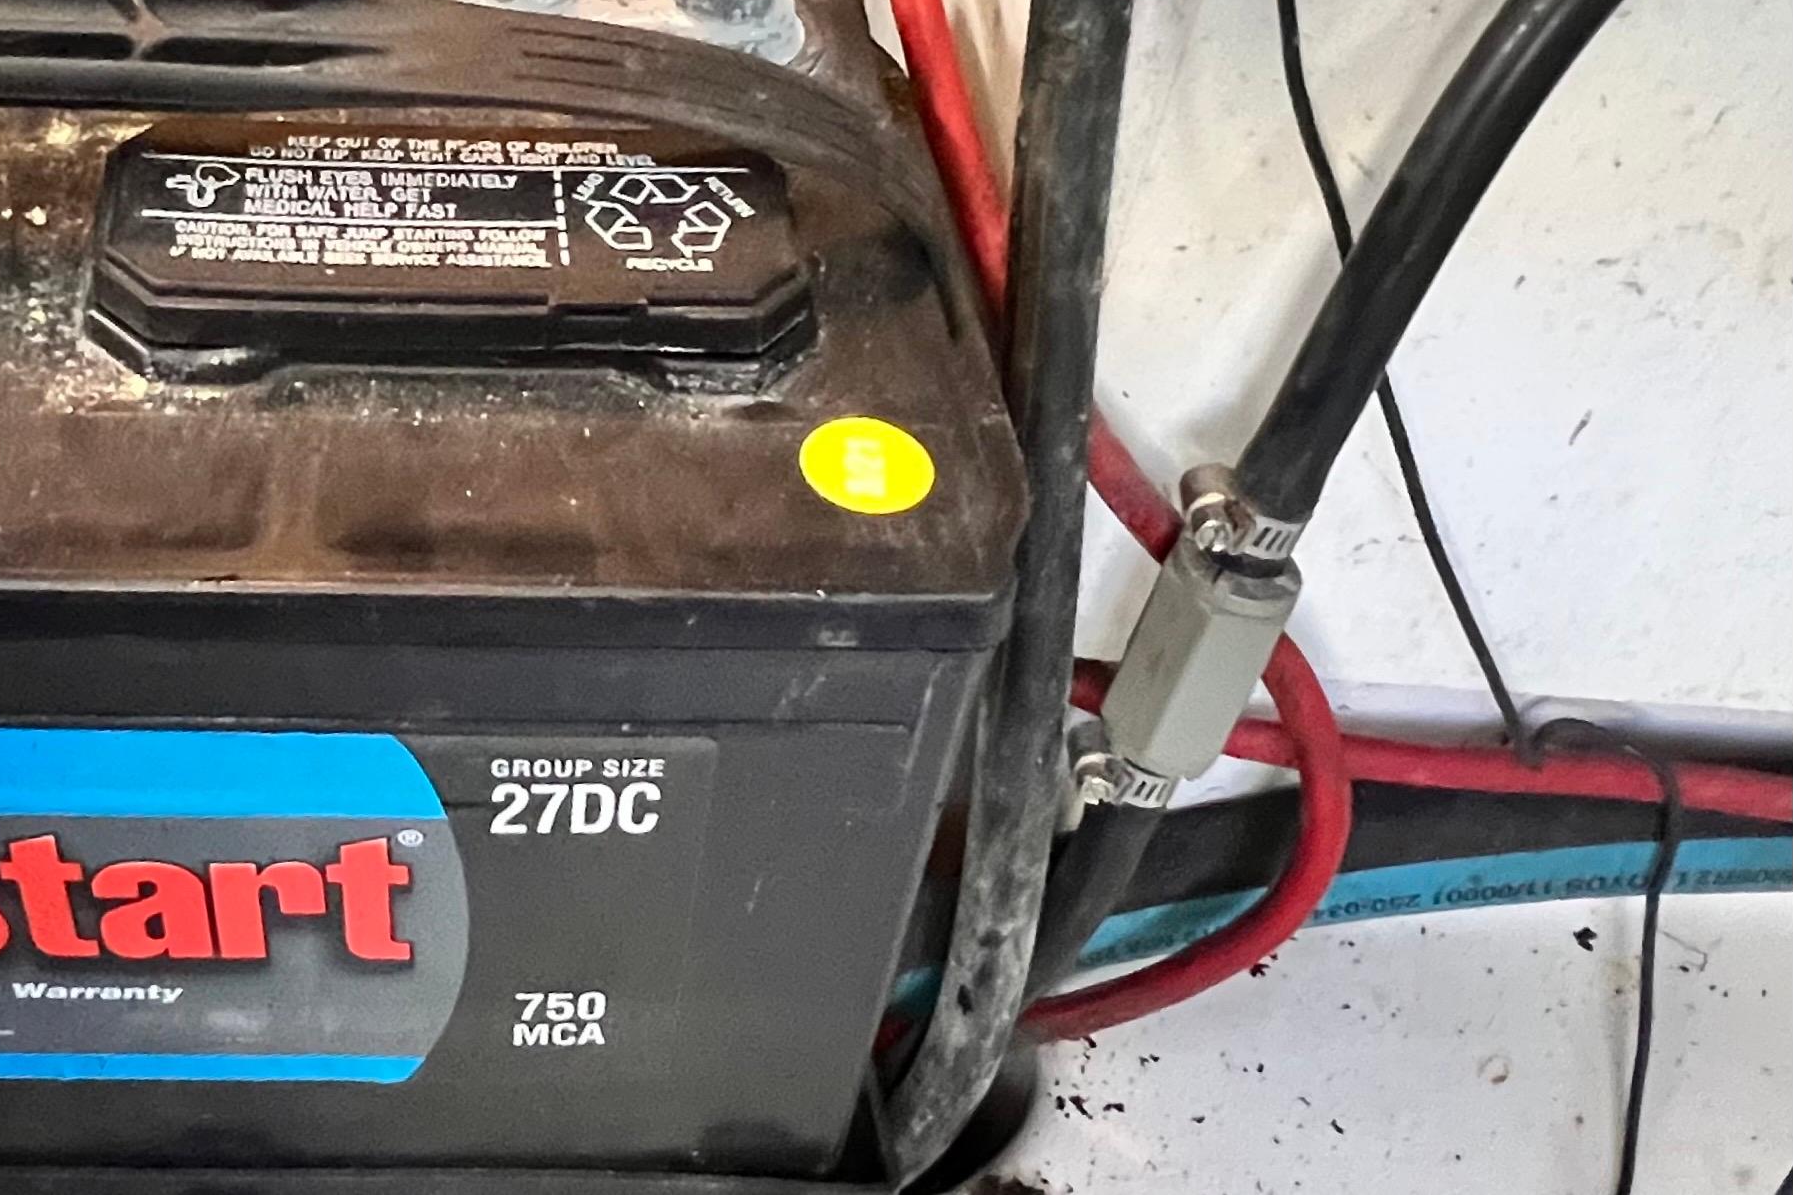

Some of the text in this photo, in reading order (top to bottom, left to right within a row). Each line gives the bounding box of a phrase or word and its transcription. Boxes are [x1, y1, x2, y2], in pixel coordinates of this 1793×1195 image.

[288, 135, 330, 148] KEEP
[337, 136, 370, 149] OUT
[377, 136, 402, 150] OF
[407, 138, 440, 151] THE
[506, 140, 531, 154] OF
[280, 147, 315, 160] NOT
[361, 149, 405, 161] KEEP
[410, 151, 452, 163] VENT
[565, 153, 601, 166] AND
[244, 167, 519, 189] FLUSH EYES IMMEDIATELY
[244, 183, 299, 200] WITH
[390, 187, 433, 203] GET
[243, 198, 458, 219] MEDICAL HELP FAST
[490, 757, 666, 779] GROUP SIZE
[489, 781, 662, 835] 27DC
[12, 982, 184, 1004] Warranty
[514, 991, 607, 1022] 750
[512, 1021, 606, 1046] MCA
